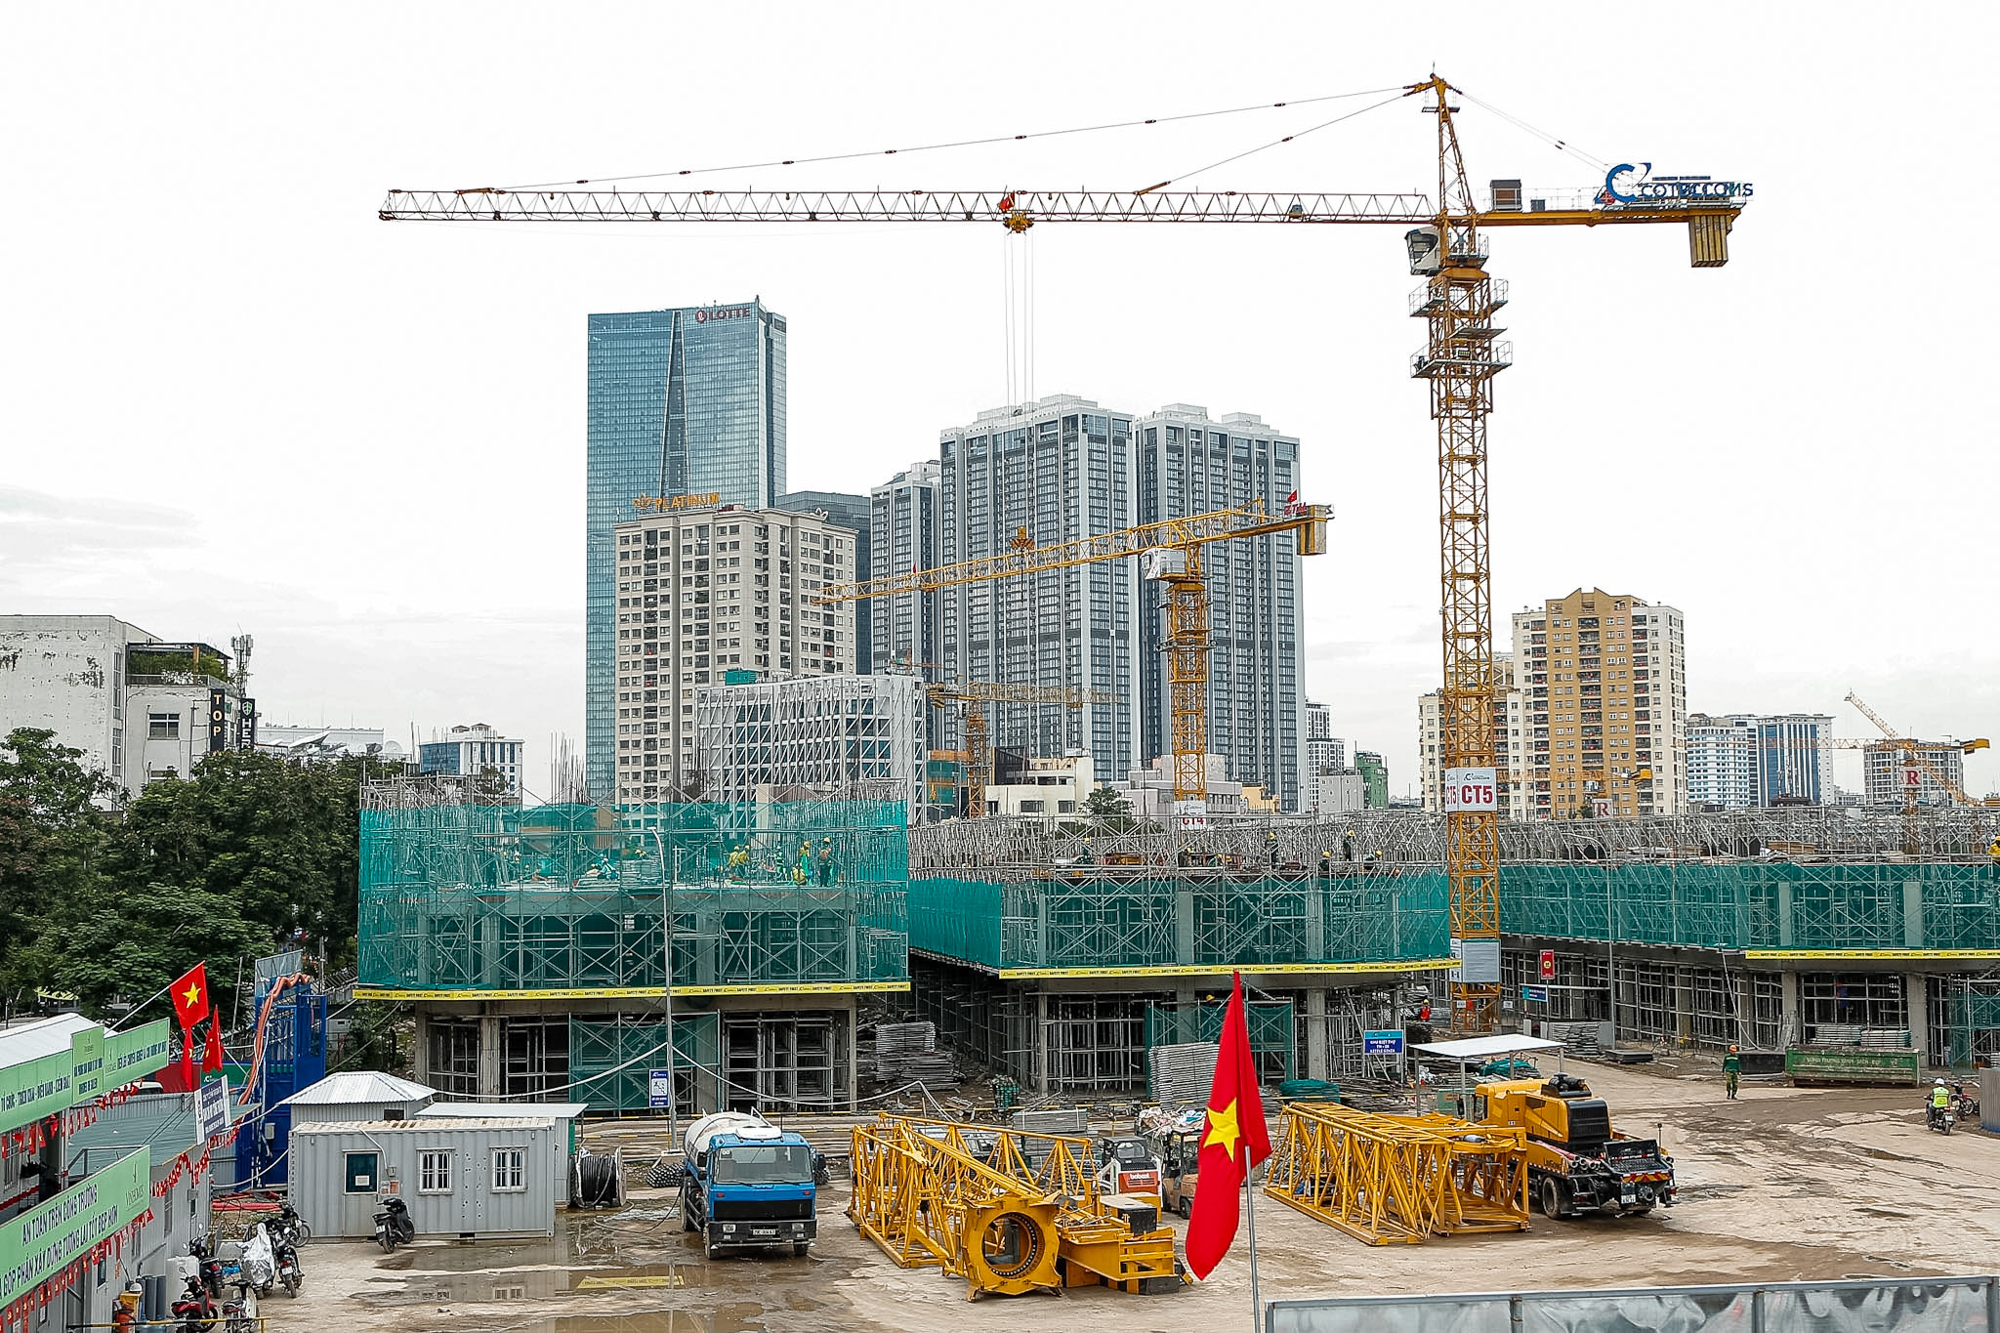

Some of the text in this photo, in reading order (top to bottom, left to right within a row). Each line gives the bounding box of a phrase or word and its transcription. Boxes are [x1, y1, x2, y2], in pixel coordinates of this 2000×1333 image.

[709, 307, 750, 321] LOTTE
[654, 491, 719, 510] PLATINUM
[213, 694, 222, 737] TOP
[1446, 786, 1457, 805] CT5
[1461, 784, 1493, 805] CT5
[23, 1221, 30, 1246] AN
[32, 1210, 47, 1238] TOÀN
[48, 1203, 62, 1230] TRÊN
